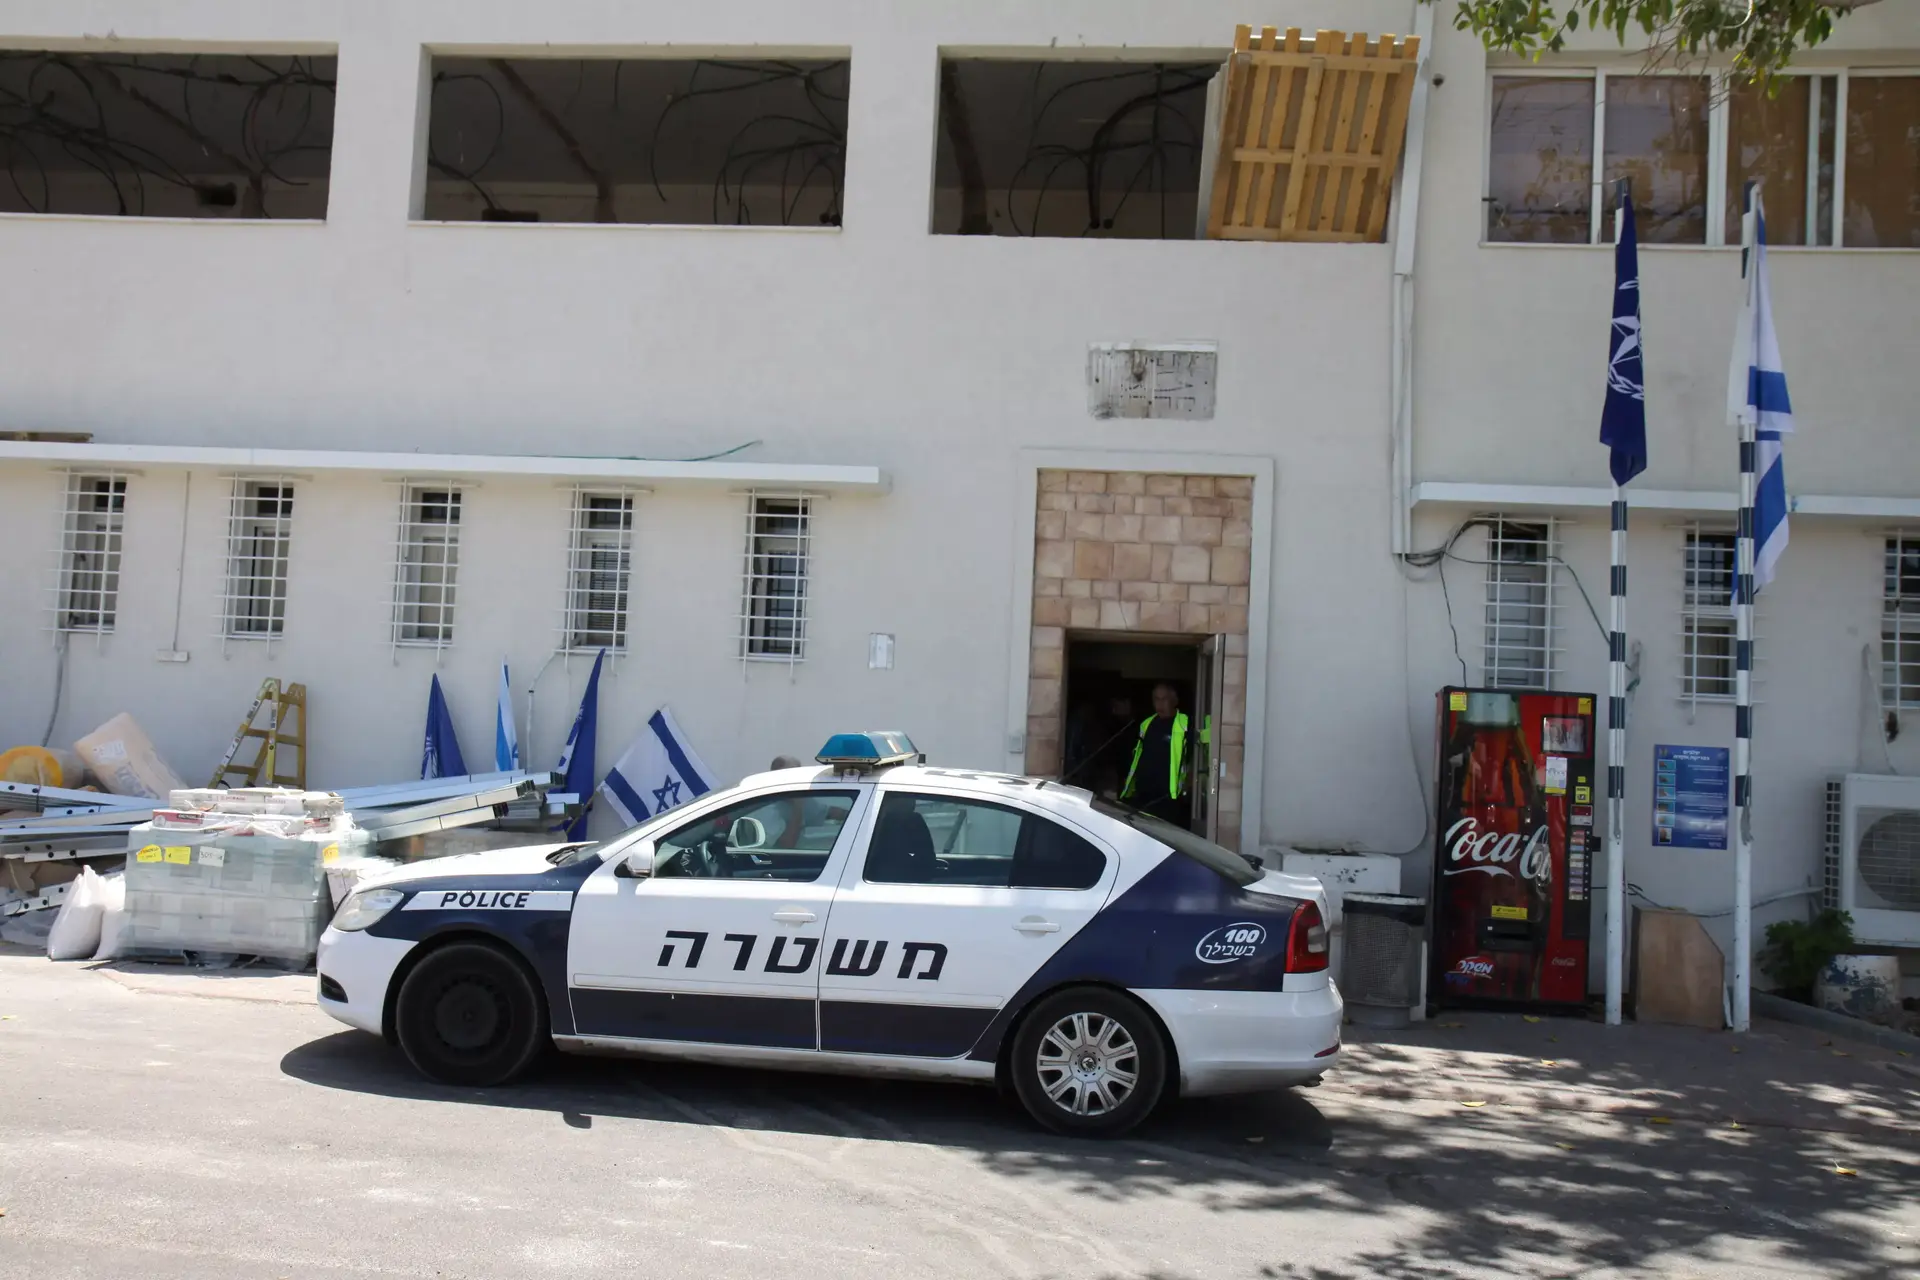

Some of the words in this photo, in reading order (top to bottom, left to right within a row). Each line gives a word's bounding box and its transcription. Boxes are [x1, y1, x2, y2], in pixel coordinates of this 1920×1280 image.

[1444, 817, 1552, 883] Coca-Co
[440, 892, 530, 908] POLICE
[1224, 929, 1260, 943] 100
[657, 930, 948, 981] משטרה
[1205, 941, 1256, 958] בשבילך
